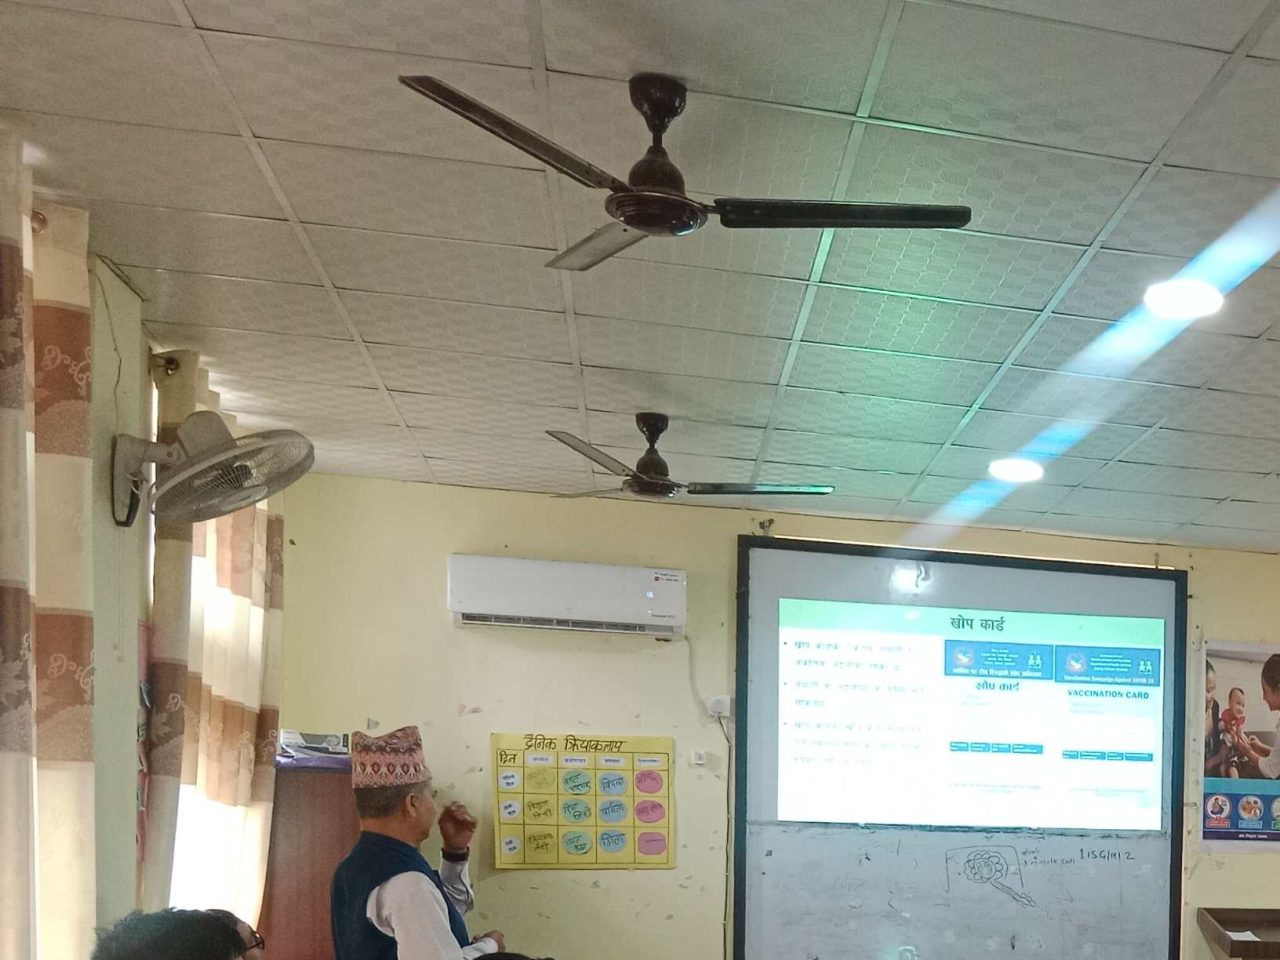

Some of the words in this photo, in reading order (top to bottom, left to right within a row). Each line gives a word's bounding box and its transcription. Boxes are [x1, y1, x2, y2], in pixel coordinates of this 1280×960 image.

[950, 615, 974, 630] खोप
[980, 616, 1006, 631] कार्ड
[1067, 689, 1123, 699] VACCINATION
[1125, 691, 1150, 700] CARD
